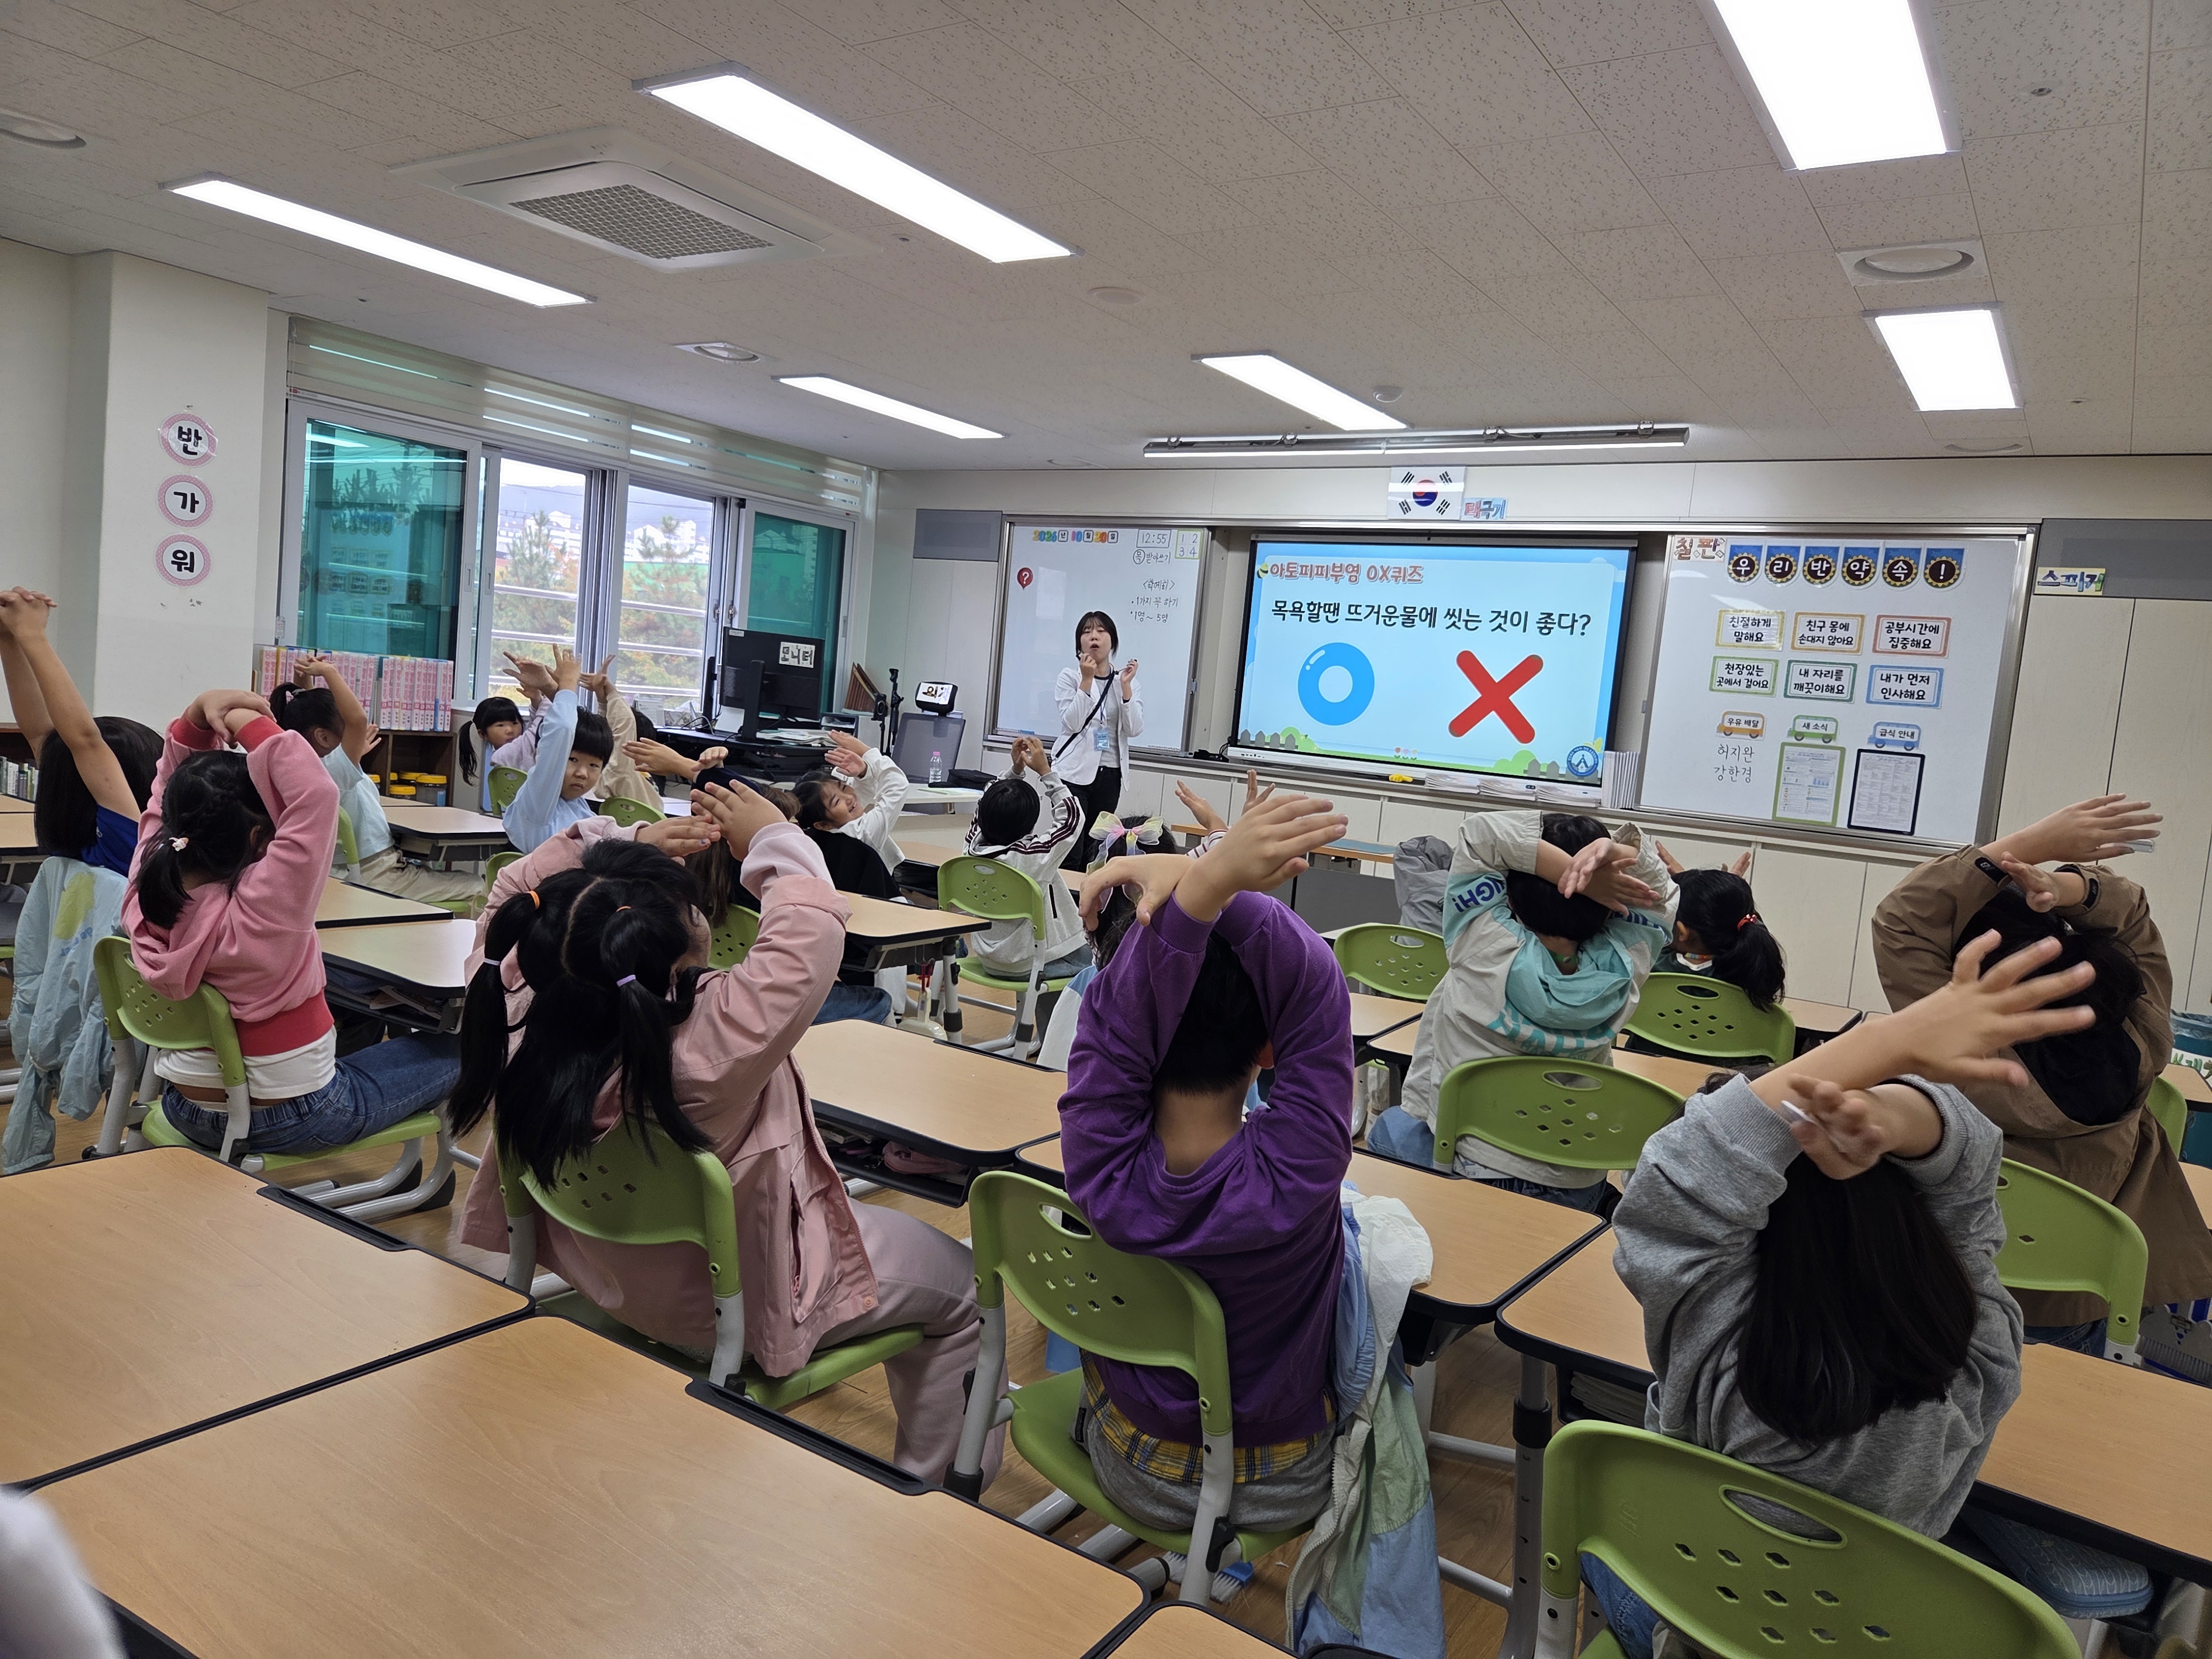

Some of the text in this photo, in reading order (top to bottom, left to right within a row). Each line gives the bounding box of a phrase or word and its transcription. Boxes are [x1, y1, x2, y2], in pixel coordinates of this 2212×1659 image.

[1465, 500, 1506, 520] 태극기
[1141, 533, 1167, 544] 12:55
[1676, 537, 1719, 560] 칠판
[1146, 552, 1171, 564] 받아쓰기
[1270, 562, 1423, 583] 아토피피부염 OX퀴즈
[2037, 570, 2105, 592] 스피커
[1164, 597, 1178, 608] 하기
[1272, 600, 1592, 636] 목욕할땐 뜨거운물에 씻는 것이 좋다?
[1729, 616, 1771, 628] 친절하게
[1806, 619, 1850, 633] 친구 몸에
[1885, 622, 1939, 635] 공부시간에
[1734, 631, 1764, 642] 말해요
[1798, 634, 1824, 644] 손대지
[1888, 637, 1932, 650] 집중해요
[781, 646, 813, 665] 모니터
[1724, 662, 1764, 677] 천장있는
[1799, 668, 1844, 681] 내 자리를
[1717, 676, 1768, 688] 곳에서 걸어요
[1880, 673, 1930, 686] 내가 먼저
[1793, 682, 1845, 695] 깨끗이해요
[1881, 687, 1926, 700] 인사해요
[1727, 718, 1759, 728] 우유 배달
[1802, 722, 1829, 731] 새 소식
[1879, 728, 1916, 739] 급식 안내
[1718, 743, 1755, 763] 허지완
[1713, 764, 1752, 784] 강한경
